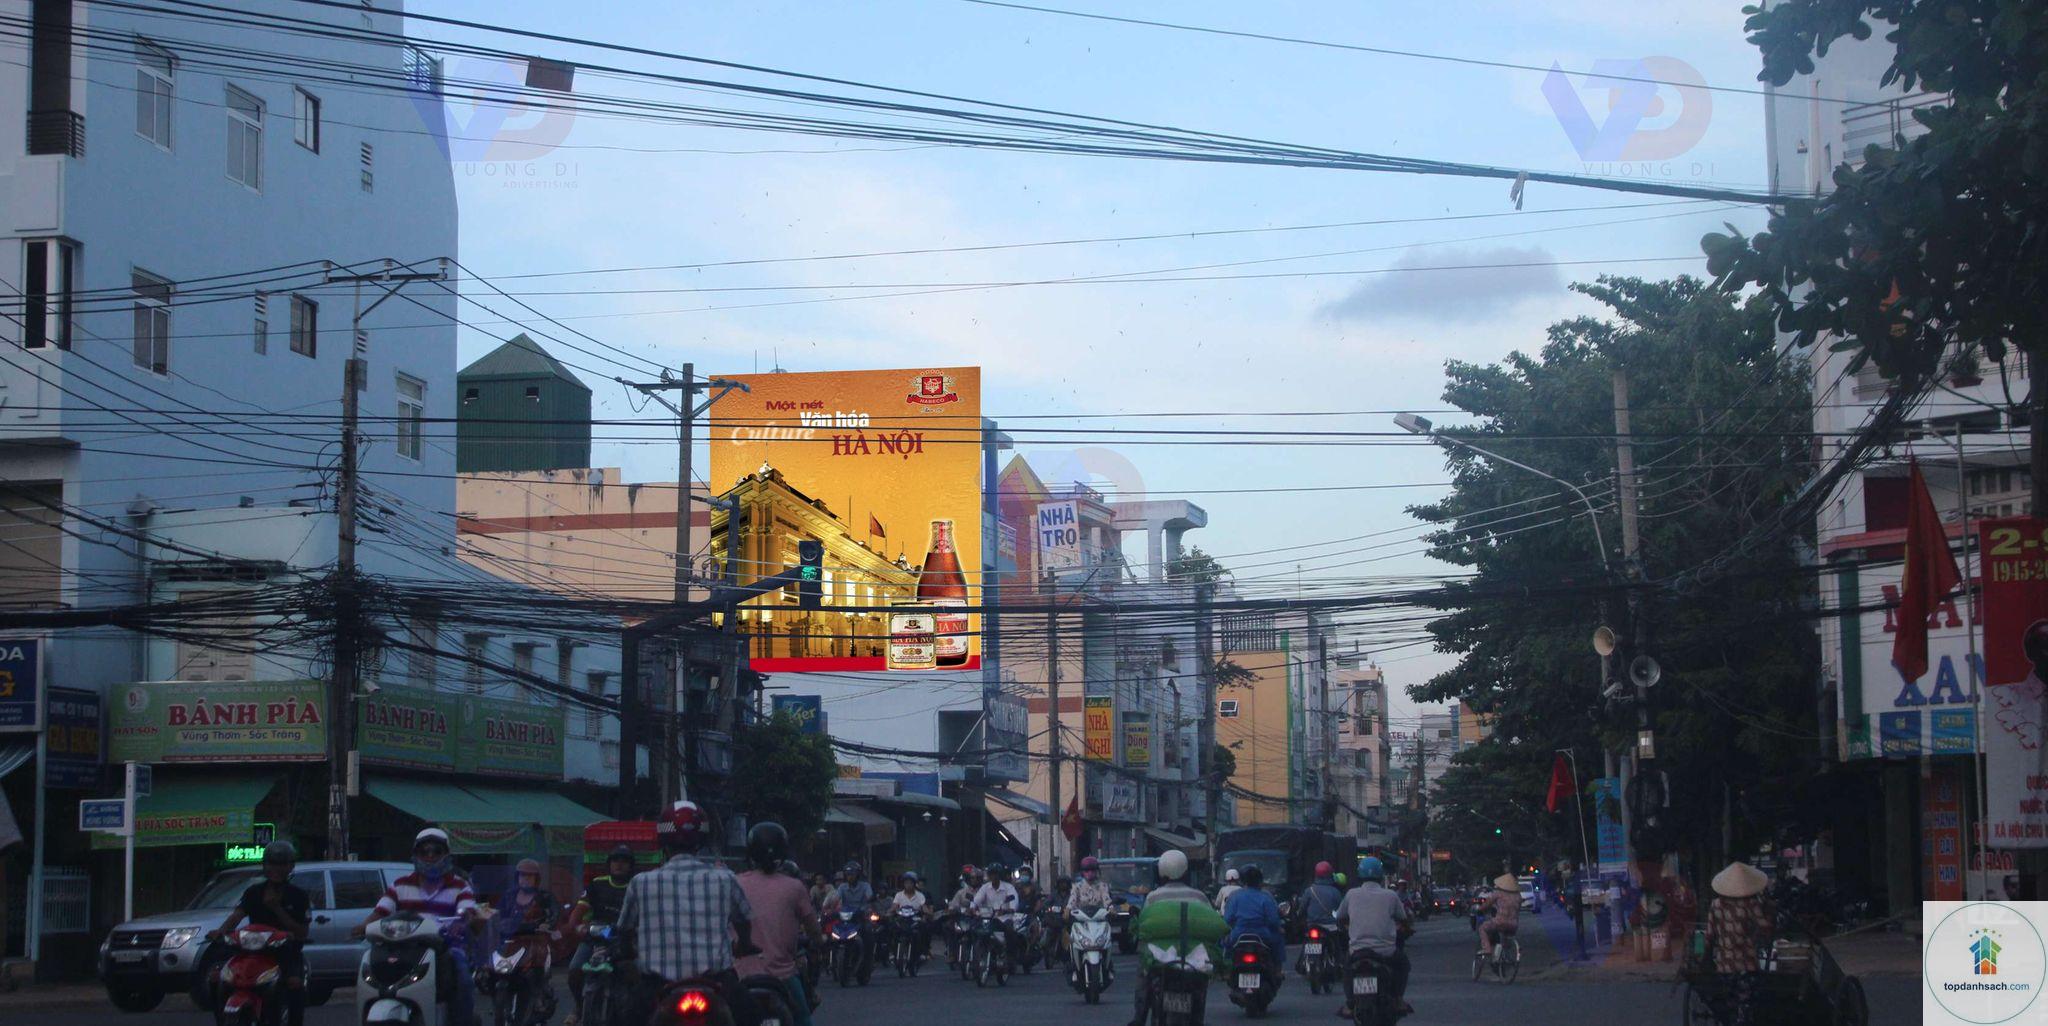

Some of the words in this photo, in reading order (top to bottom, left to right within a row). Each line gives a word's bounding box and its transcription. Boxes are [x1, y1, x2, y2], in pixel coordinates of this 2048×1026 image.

[766, 400, 796, 411] Một
[800, 400, 824, 410] nét
[800, 411, 832, 427] Văn
[836, 410, 870, 428] hóa
[731, 421, 815, 446] Culture
[832, 430, 871, 456] HÀ
[877, 427, 924, 460] NỘI
[1040, 504, 1075, 526] NHÀ
[1042, 528, 1077, 549] TRỌ
[168, 699, 257, 726] BÁNH
[266, 697, 320, 724] PÍA
[366, 698, 415, 730] BÁNH
[419, 708, 448, 734] PÍA
[1088, 710, 1109, 731] NHÀ
[486, 713, 528, 742] BÁNH
[532, 720, 556, 746] PÍA
[1087, 732, 1112, 755] NGHỈ
